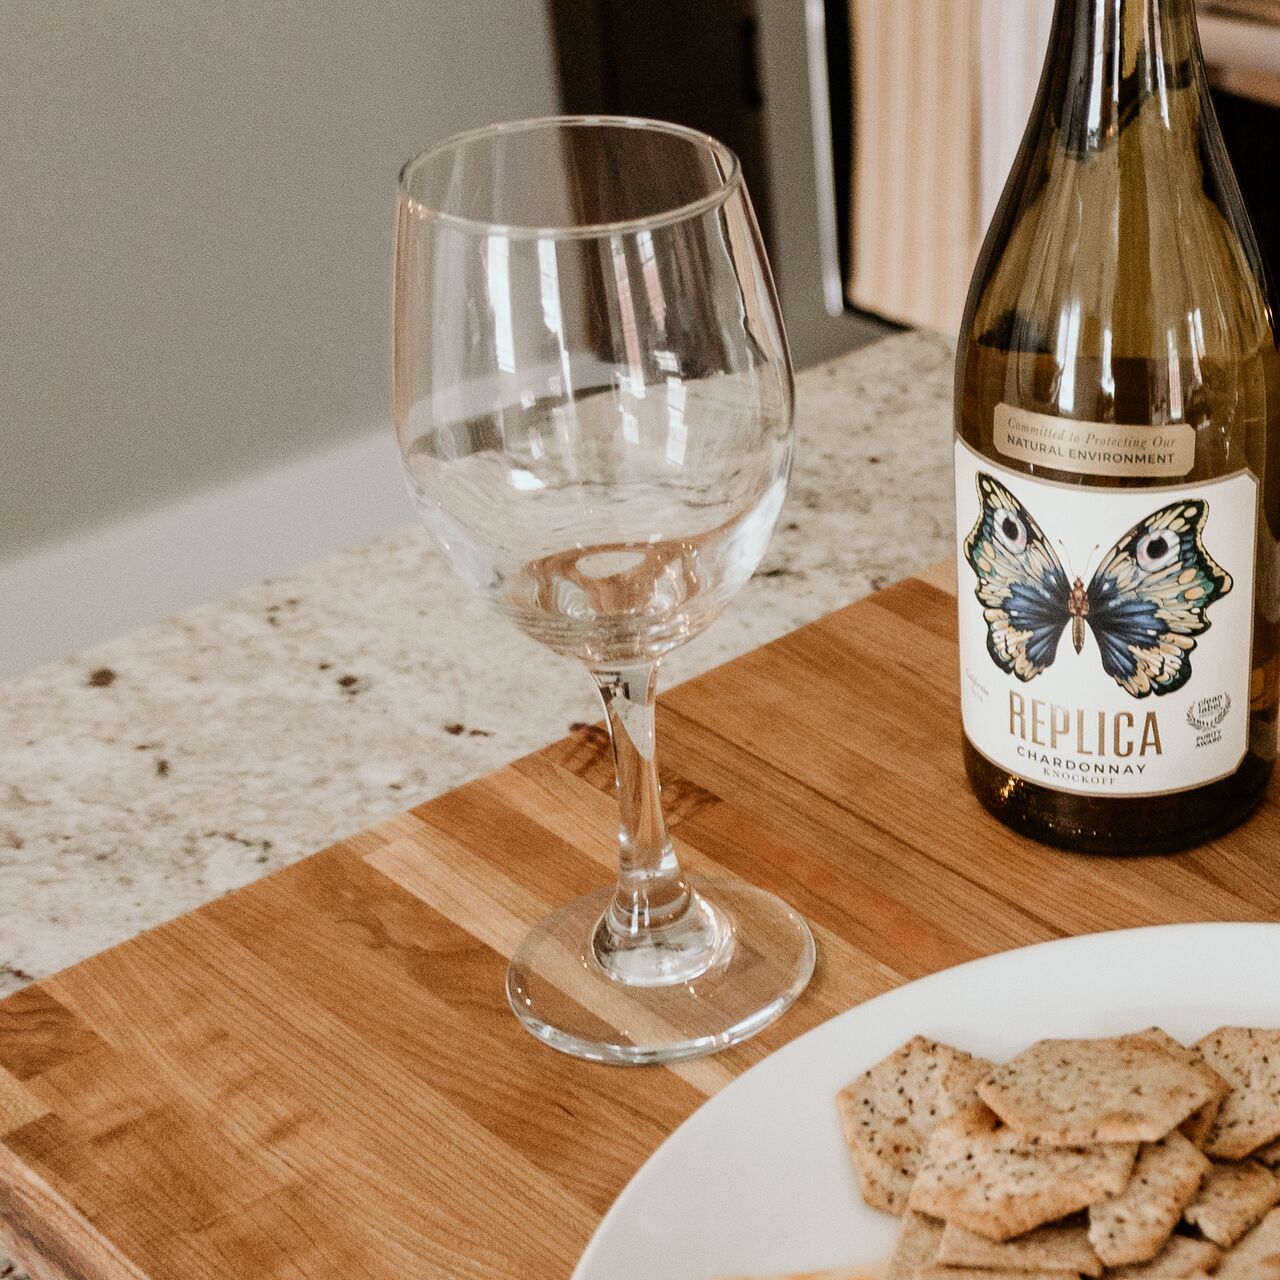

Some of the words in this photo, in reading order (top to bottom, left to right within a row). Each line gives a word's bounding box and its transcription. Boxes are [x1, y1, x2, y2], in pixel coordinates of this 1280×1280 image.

[1007, 416, 1066, 441] Committed
[1069, 428, 1080, 442] to
[1085, 430, 1148, 450] Protecting
[1152, 434, 1177, 448] Our
[1007, 434, 1064, 458] NATURAL
[1069, 449, 1176, 465] ENVIRONMENT
[1009, 688, 1163, 758] REPLICA
[1016, 745, 1146, 775] CHARDONNAY
[1043, 767, 1117, 786] KNOCKOFF
